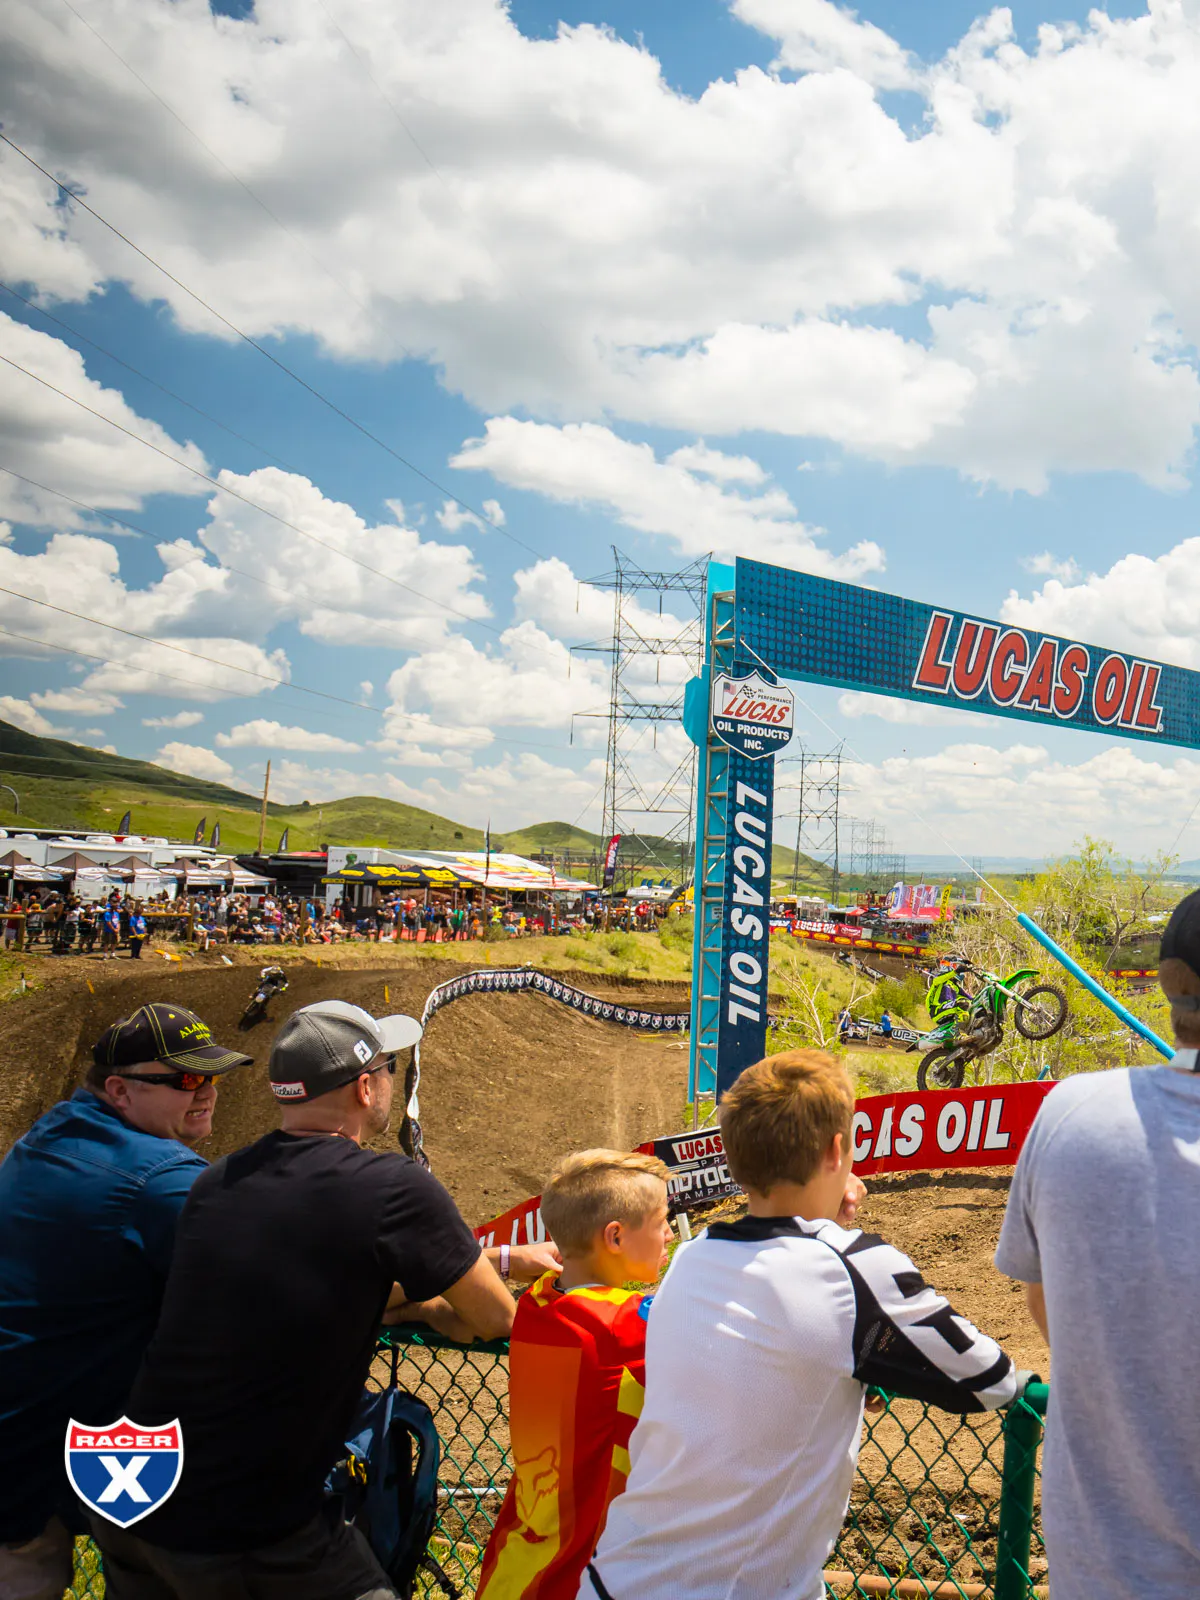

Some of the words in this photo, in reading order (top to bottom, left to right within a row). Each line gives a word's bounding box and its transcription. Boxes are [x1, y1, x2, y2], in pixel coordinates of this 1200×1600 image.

[912, 610, 1090, 719] LUCAS
[1093, 653, 1163, 733] OIL
[722, 696, 790, 724] LUCAS
[757, 694, 792, 704] PERFORMANCE
[716, 720, 734, 732] OIL
[737, 723, 790, 741] PRODUCTS
[743, 738, 764, 751] INC.
[730, 780, 767, 941] LUCAS
[795, 919, 822, 932] LUCAS
[823, 922, 836, 934] OIL
[727, 951, 762, 1026] OIL
[272, 1084, 304, 1096] Titleist
[853, 1103, 926, 1163] CAS
[936, 1098, 1011, 1153] OIL
[678, 1136, 723, 1161] LUCAS
[701, 1156, 720, 1168] PR
[667, 1164, 731, 1195] MOTOC
